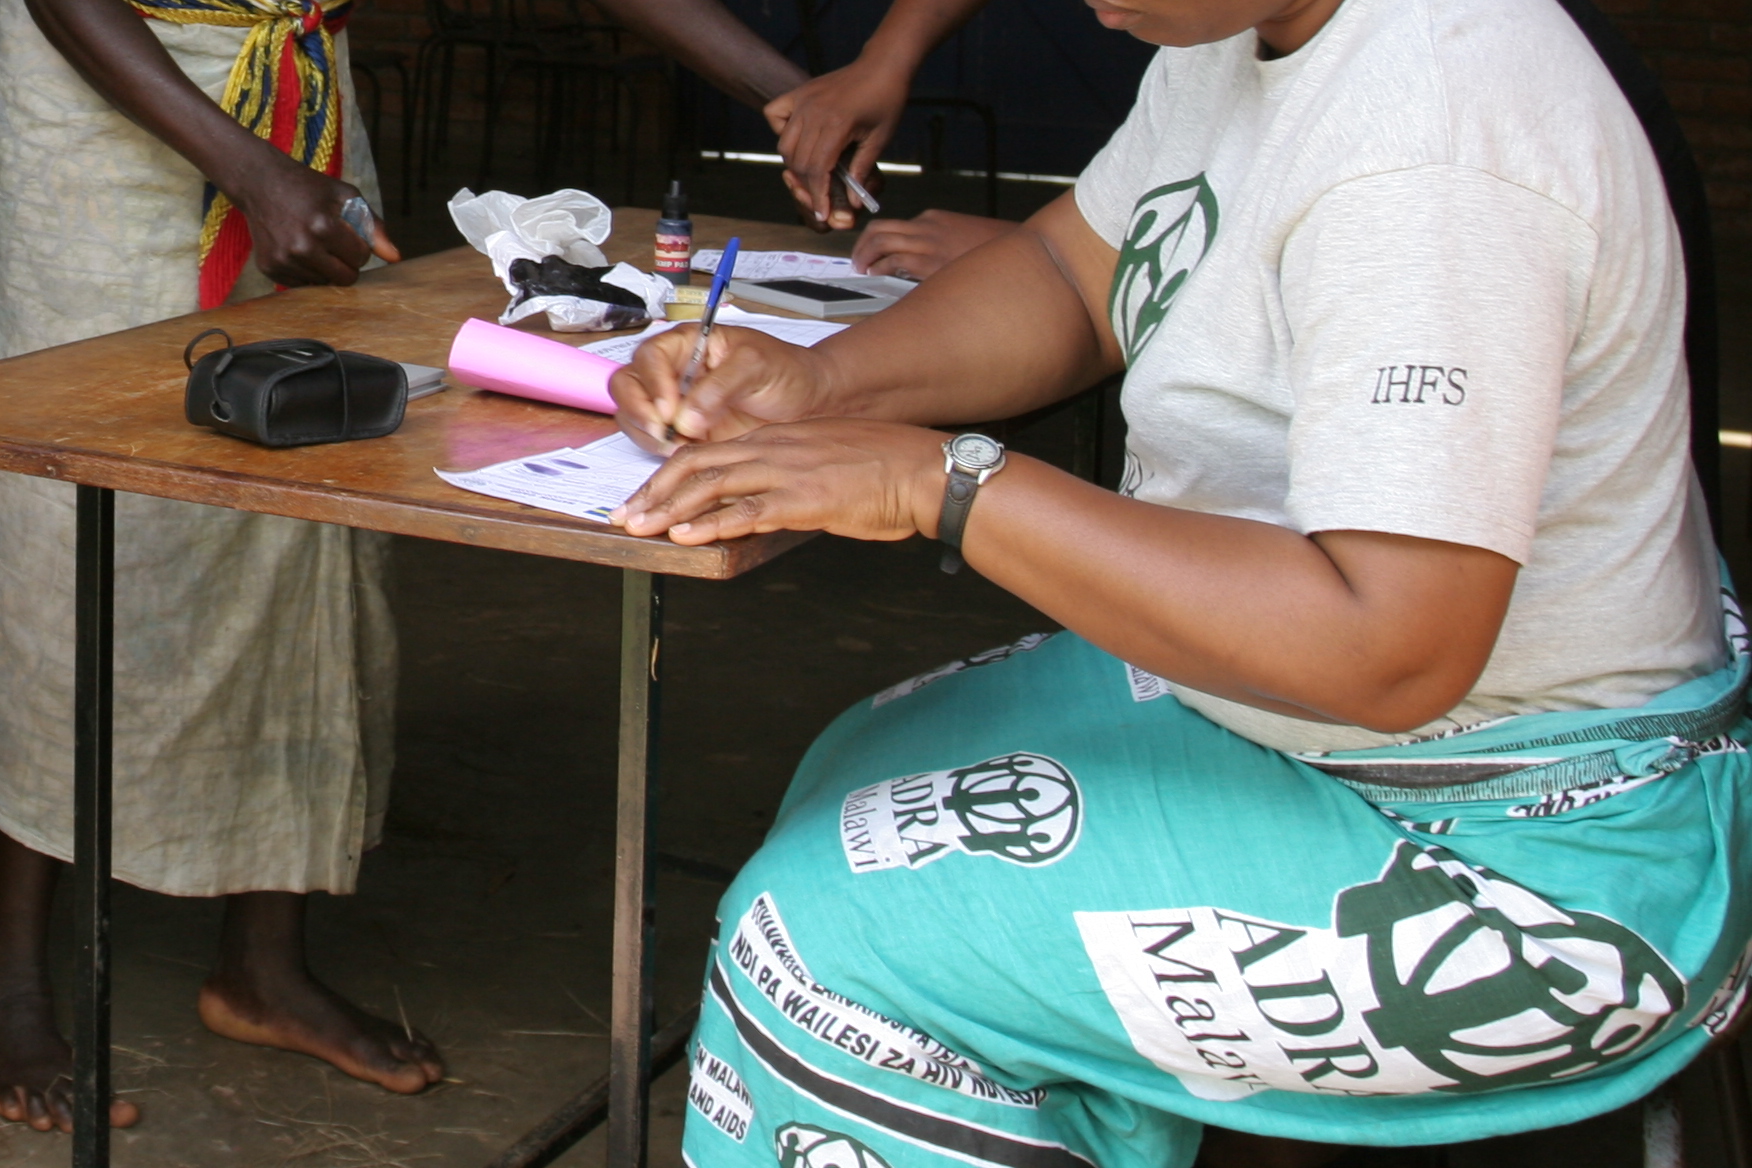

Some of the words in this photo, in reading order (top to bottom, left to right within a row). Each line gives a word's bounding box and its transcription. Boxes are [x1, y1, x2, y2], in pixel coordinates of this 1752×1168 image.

[1371, 365, 1468, 406] IHFS
[890, 773, 949, 866] ADRA
[731, 931, 759, 977] NDI
[758, 964, 782, 1008] PA
[782, 989, 880, 1061] WAILESI
[879, 1048, 916, 1075] ZA
[920, 1061, 963, 1089] HIV
[1212, 908, 1399, 1096] ADR
[689, 1083, 714, 1116] AND
[712, 1104, 747, 1141] AIDS
